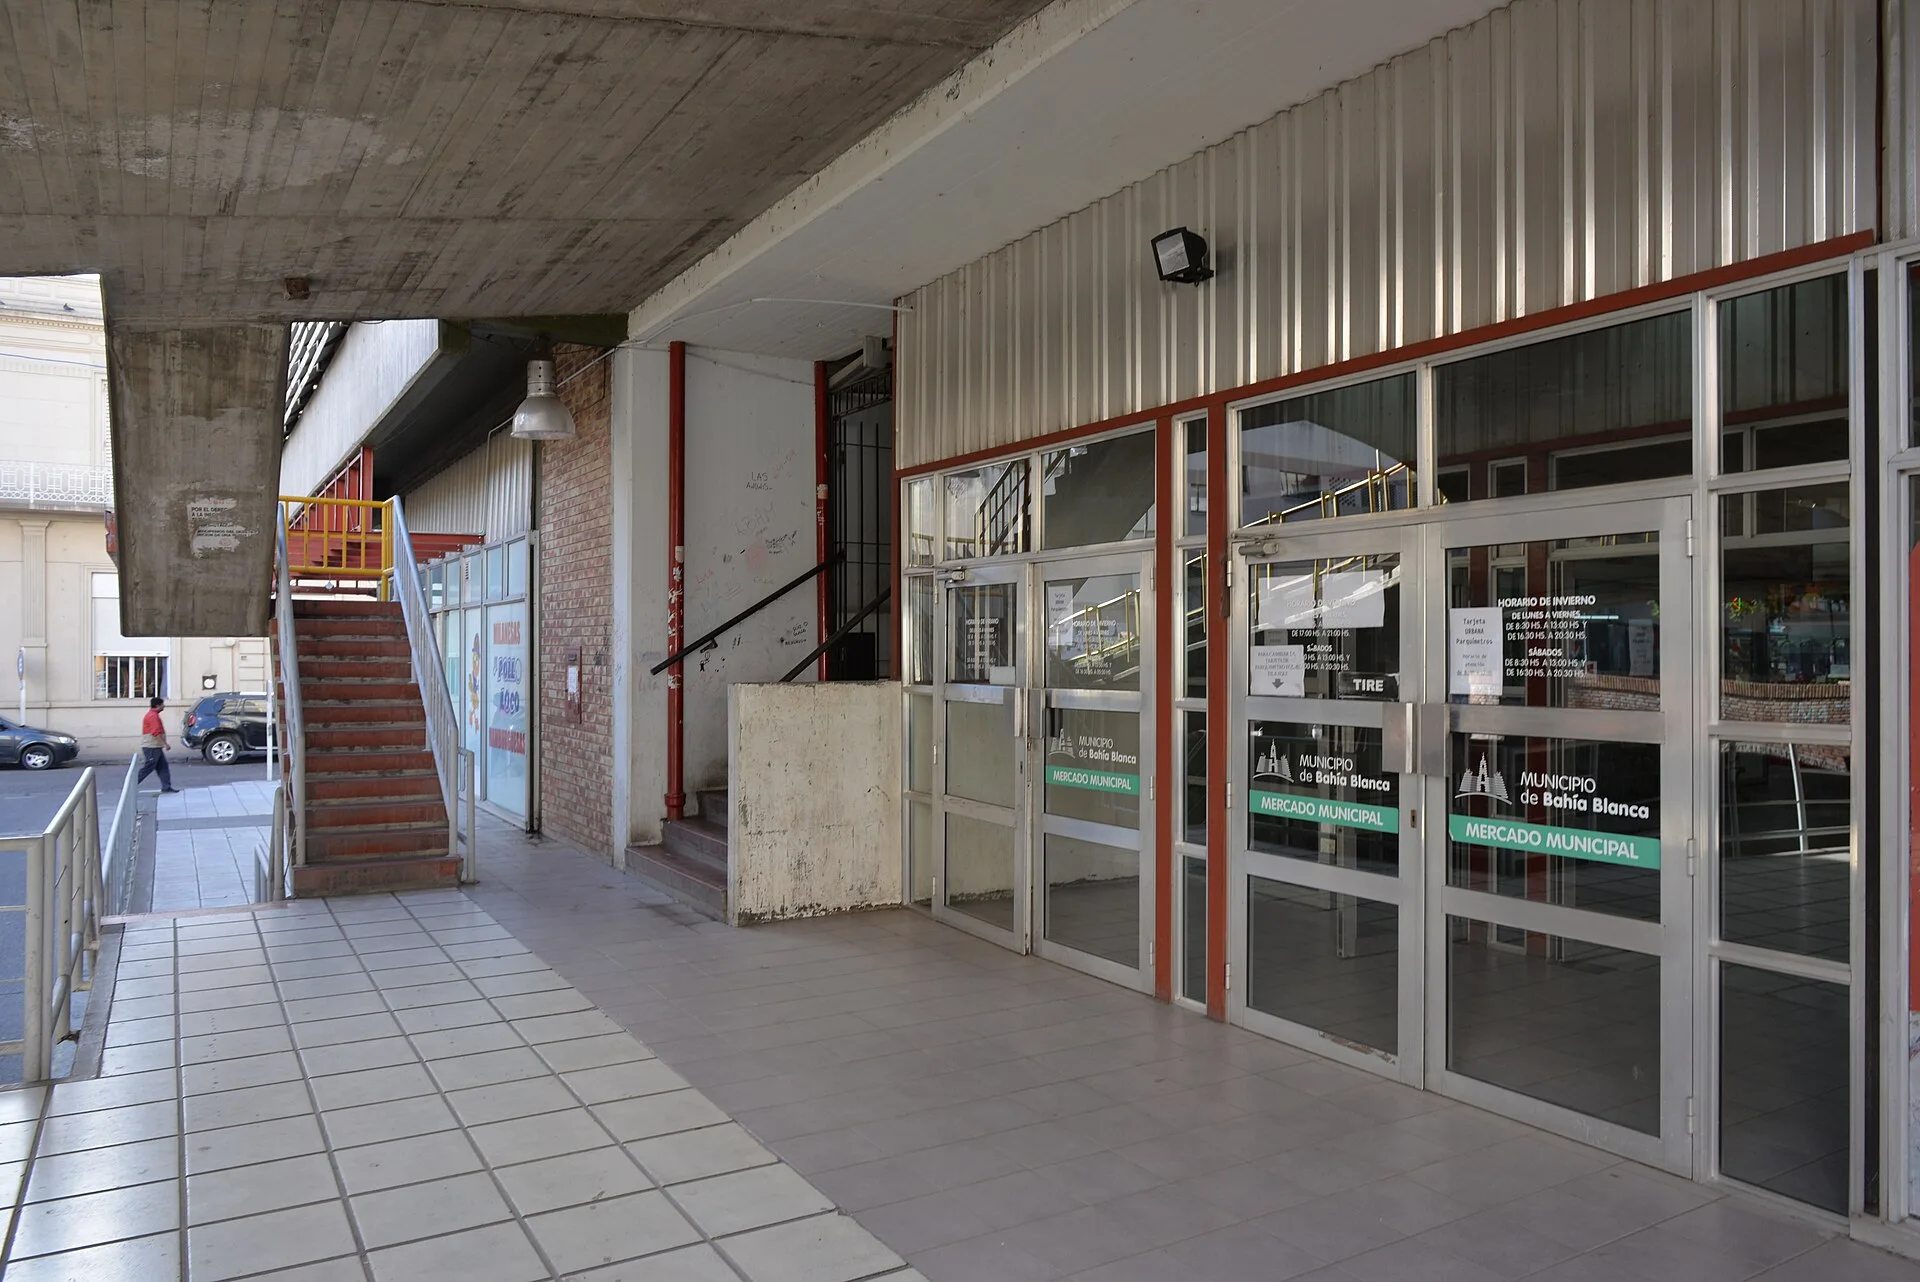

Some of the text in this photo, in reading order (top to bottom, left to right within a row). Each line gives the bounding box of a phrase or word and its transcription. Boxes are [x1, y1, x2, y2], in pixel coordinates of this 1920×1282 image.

[1498, 596, 1595, 607] HORARIO DE INVIERNO
[1552, 610, 1580, 619] VIERNES
[1551, 621, 1568, 629] 13:00
[1529, 647, 1562, 656] SÁBADOS
[1353, 679, 1384, 691] TIRE
[1079, 736, 1113, 749] MUNICIPIO
[1079, 748, 1136, 764] de Bahía Blanca
[1300, 754, 1353, 772] MUNICIPIO
[1053, 770, 1131, 790] MERCADO MUNICIPAL
[1300, 771, 1390, 791] de Bahía Blanca
[1520, 772, 1596, 793] MUNICIPIO
[1261, 796, 1383, 826] MERCADO MUNICIPAL
[1520, 789, 1649, 819] de Bahía Blanca
[1466, 822, 1639, 860] MERCADO MUNICIPAL
